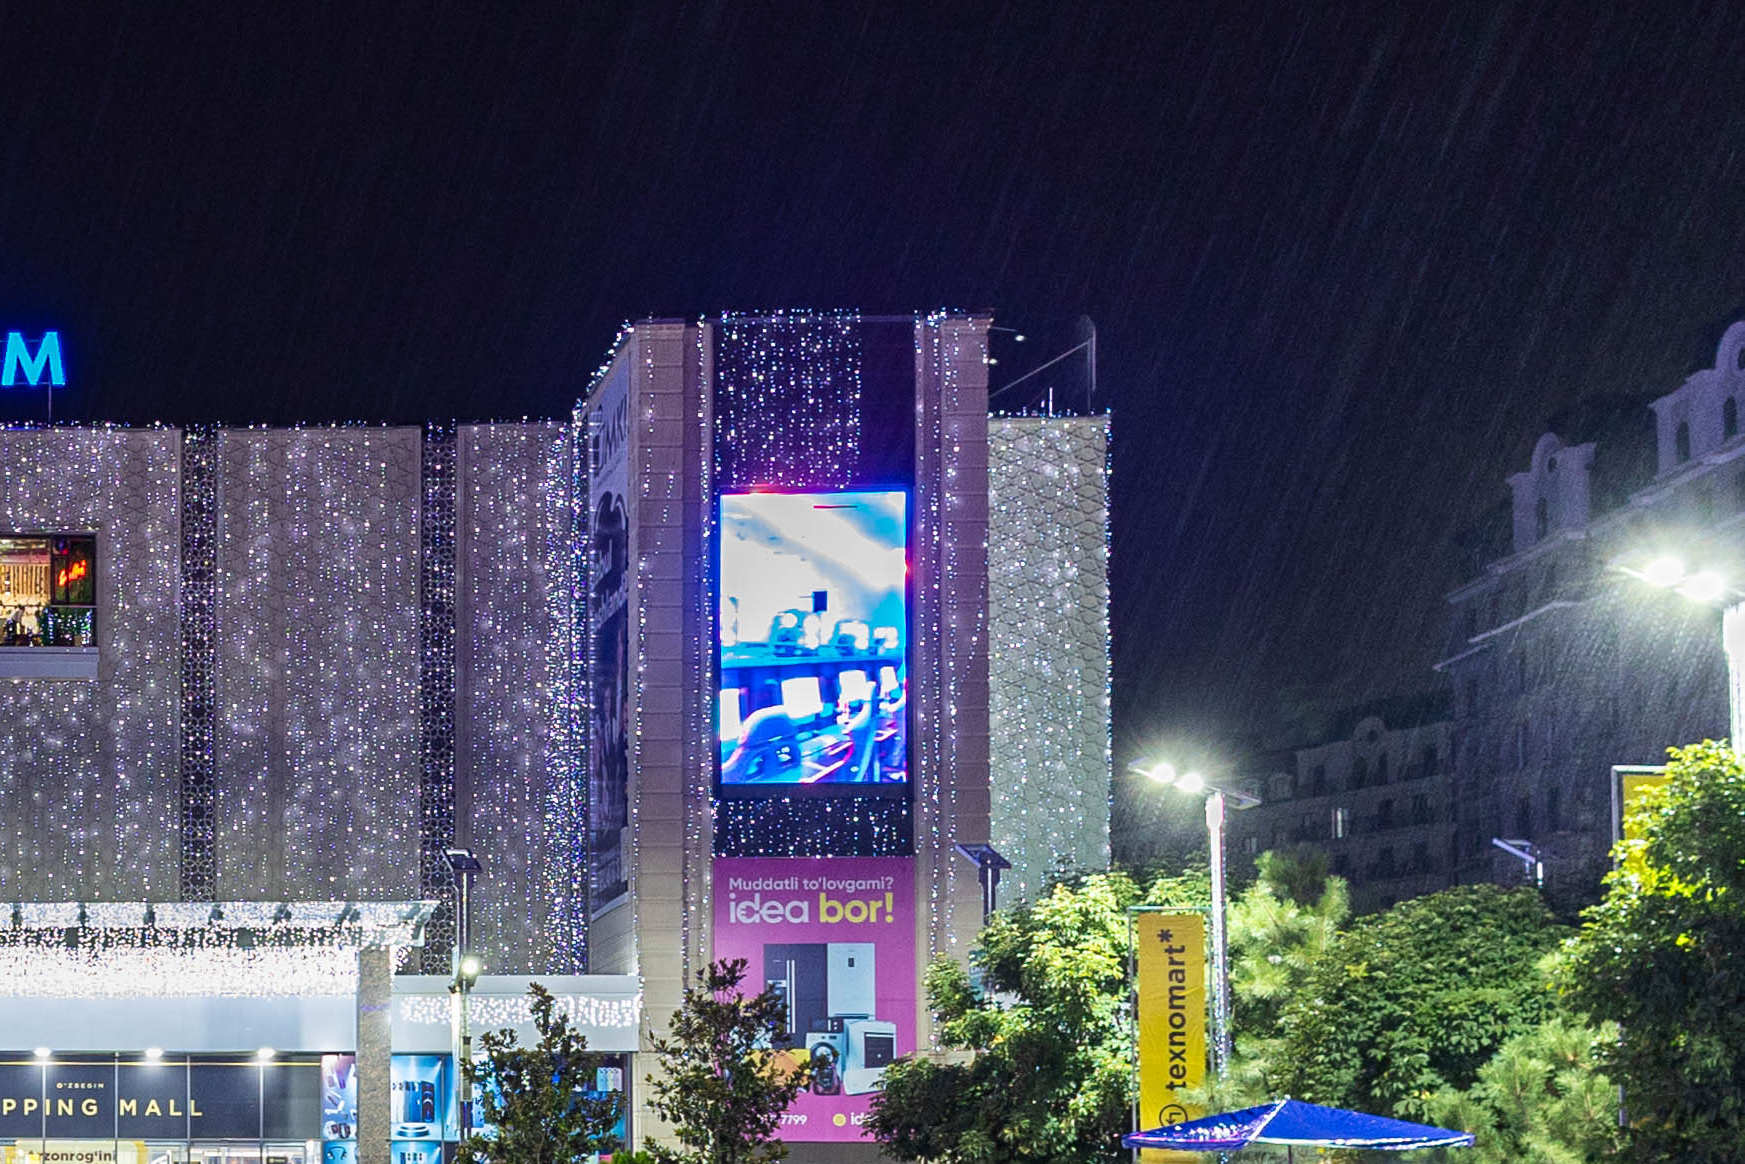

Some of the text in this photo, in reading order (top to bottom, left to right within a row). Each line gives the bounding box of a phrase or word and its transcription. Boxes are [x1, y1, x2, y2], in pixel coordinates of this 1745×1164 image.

[728, 876, 895, 894] Muddatli to'lovgami?
[729, 892, 895, 924] idea bor!
[118, 1098, 203, 1117] MALL
